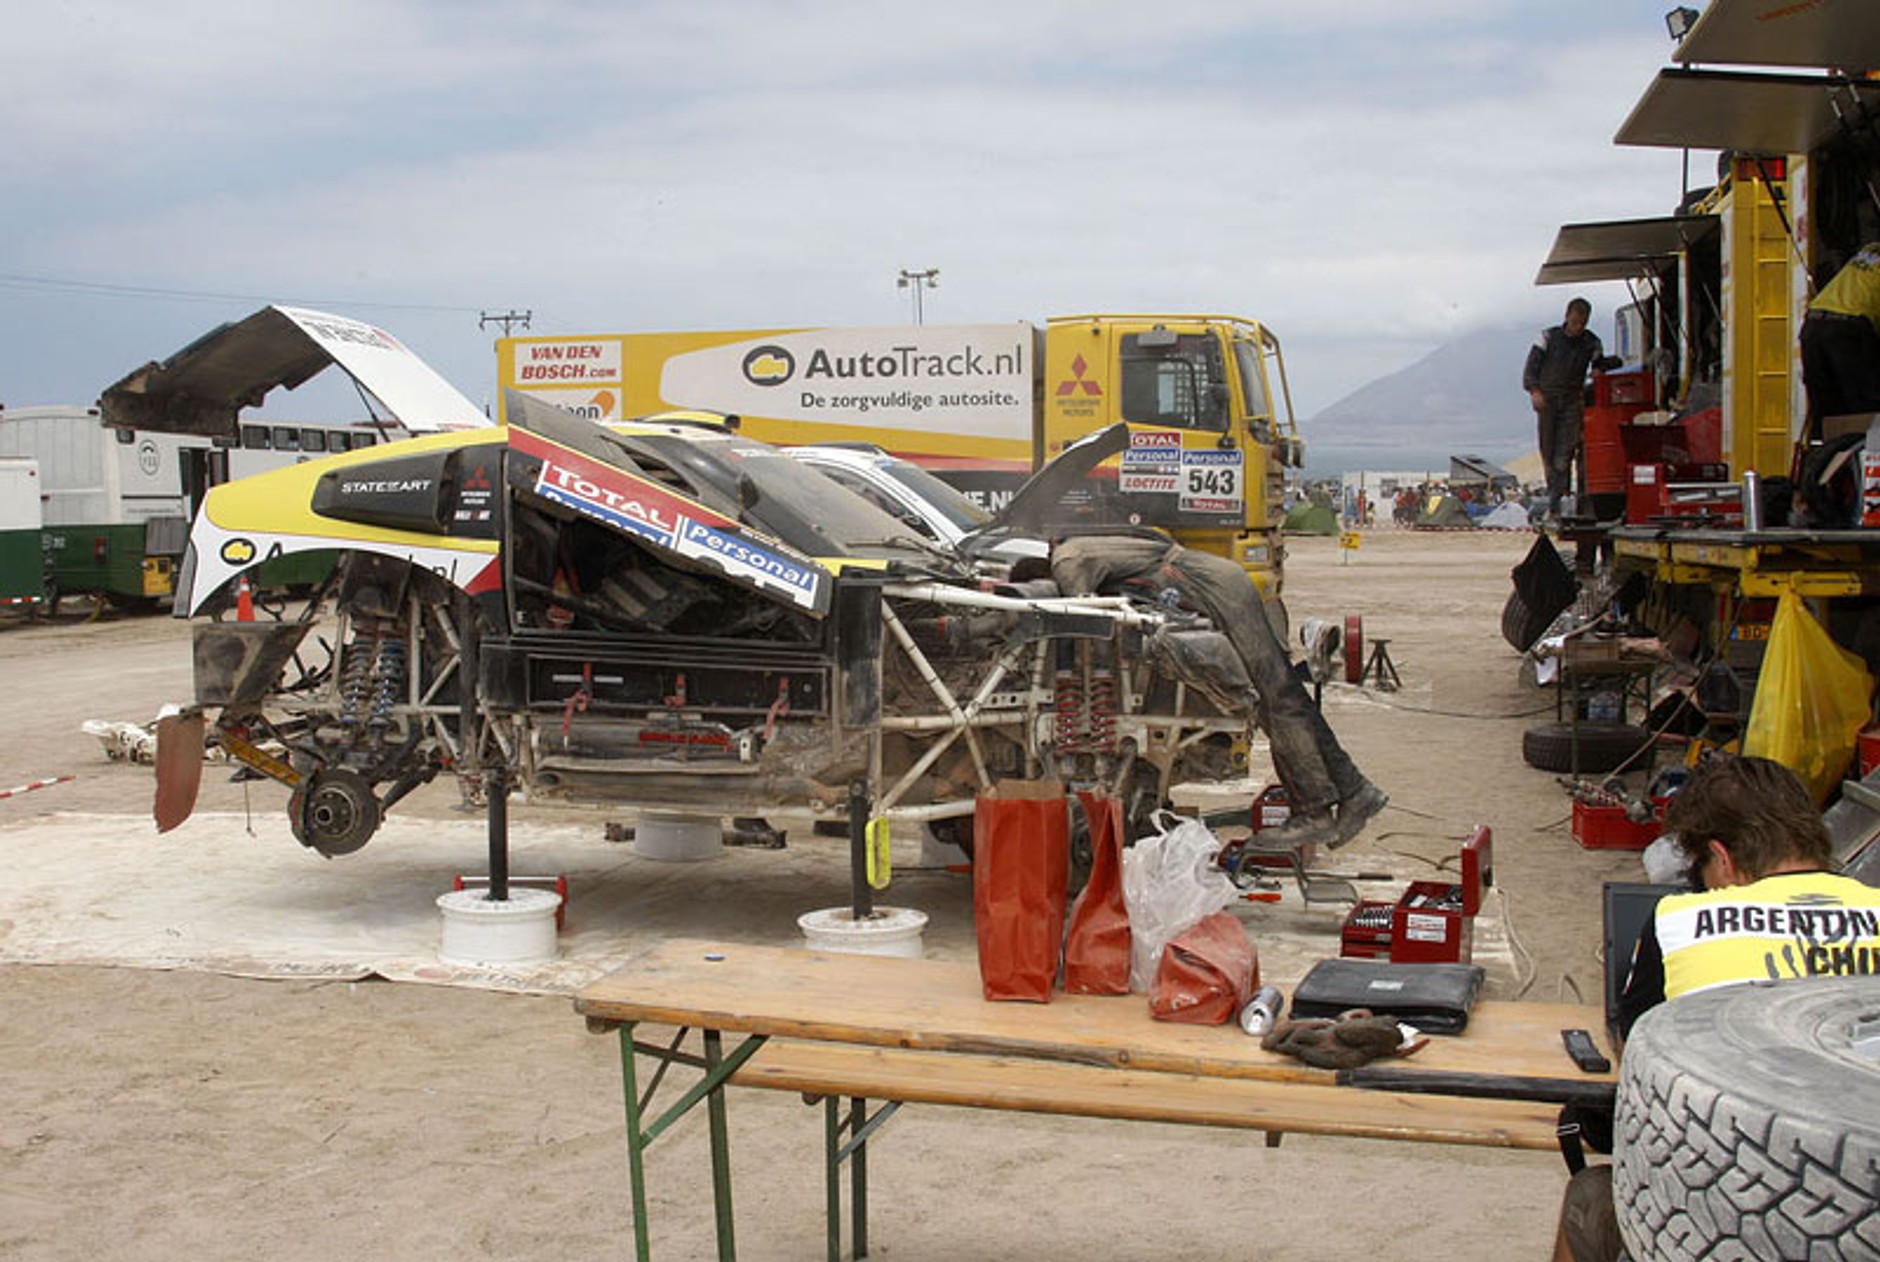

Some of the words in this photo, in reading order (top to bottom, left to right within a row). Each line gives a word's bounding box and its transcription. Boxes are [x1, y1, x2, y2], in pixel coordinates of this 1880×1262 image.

[531, 346, 565, 360] VAN
[566, 345, 603, 359] DEN
[804, 344, 1022, 379] AutoTrack.nl
[800, 392, 826, 408] De
[831, 391, 932, 411] zorgvuldige
[939, 390, 1019, 407] autosite.
[1134, 434, 1179, 446] OTAL
[1125, 450, 1179, 461] Personal
[1124, 477, 1177, 490] LOCTITE
[1188, 468, 1235, 495] 543
[551, 464, 672, 530] TOTAL
[689, 524, 811, 587] Personal
